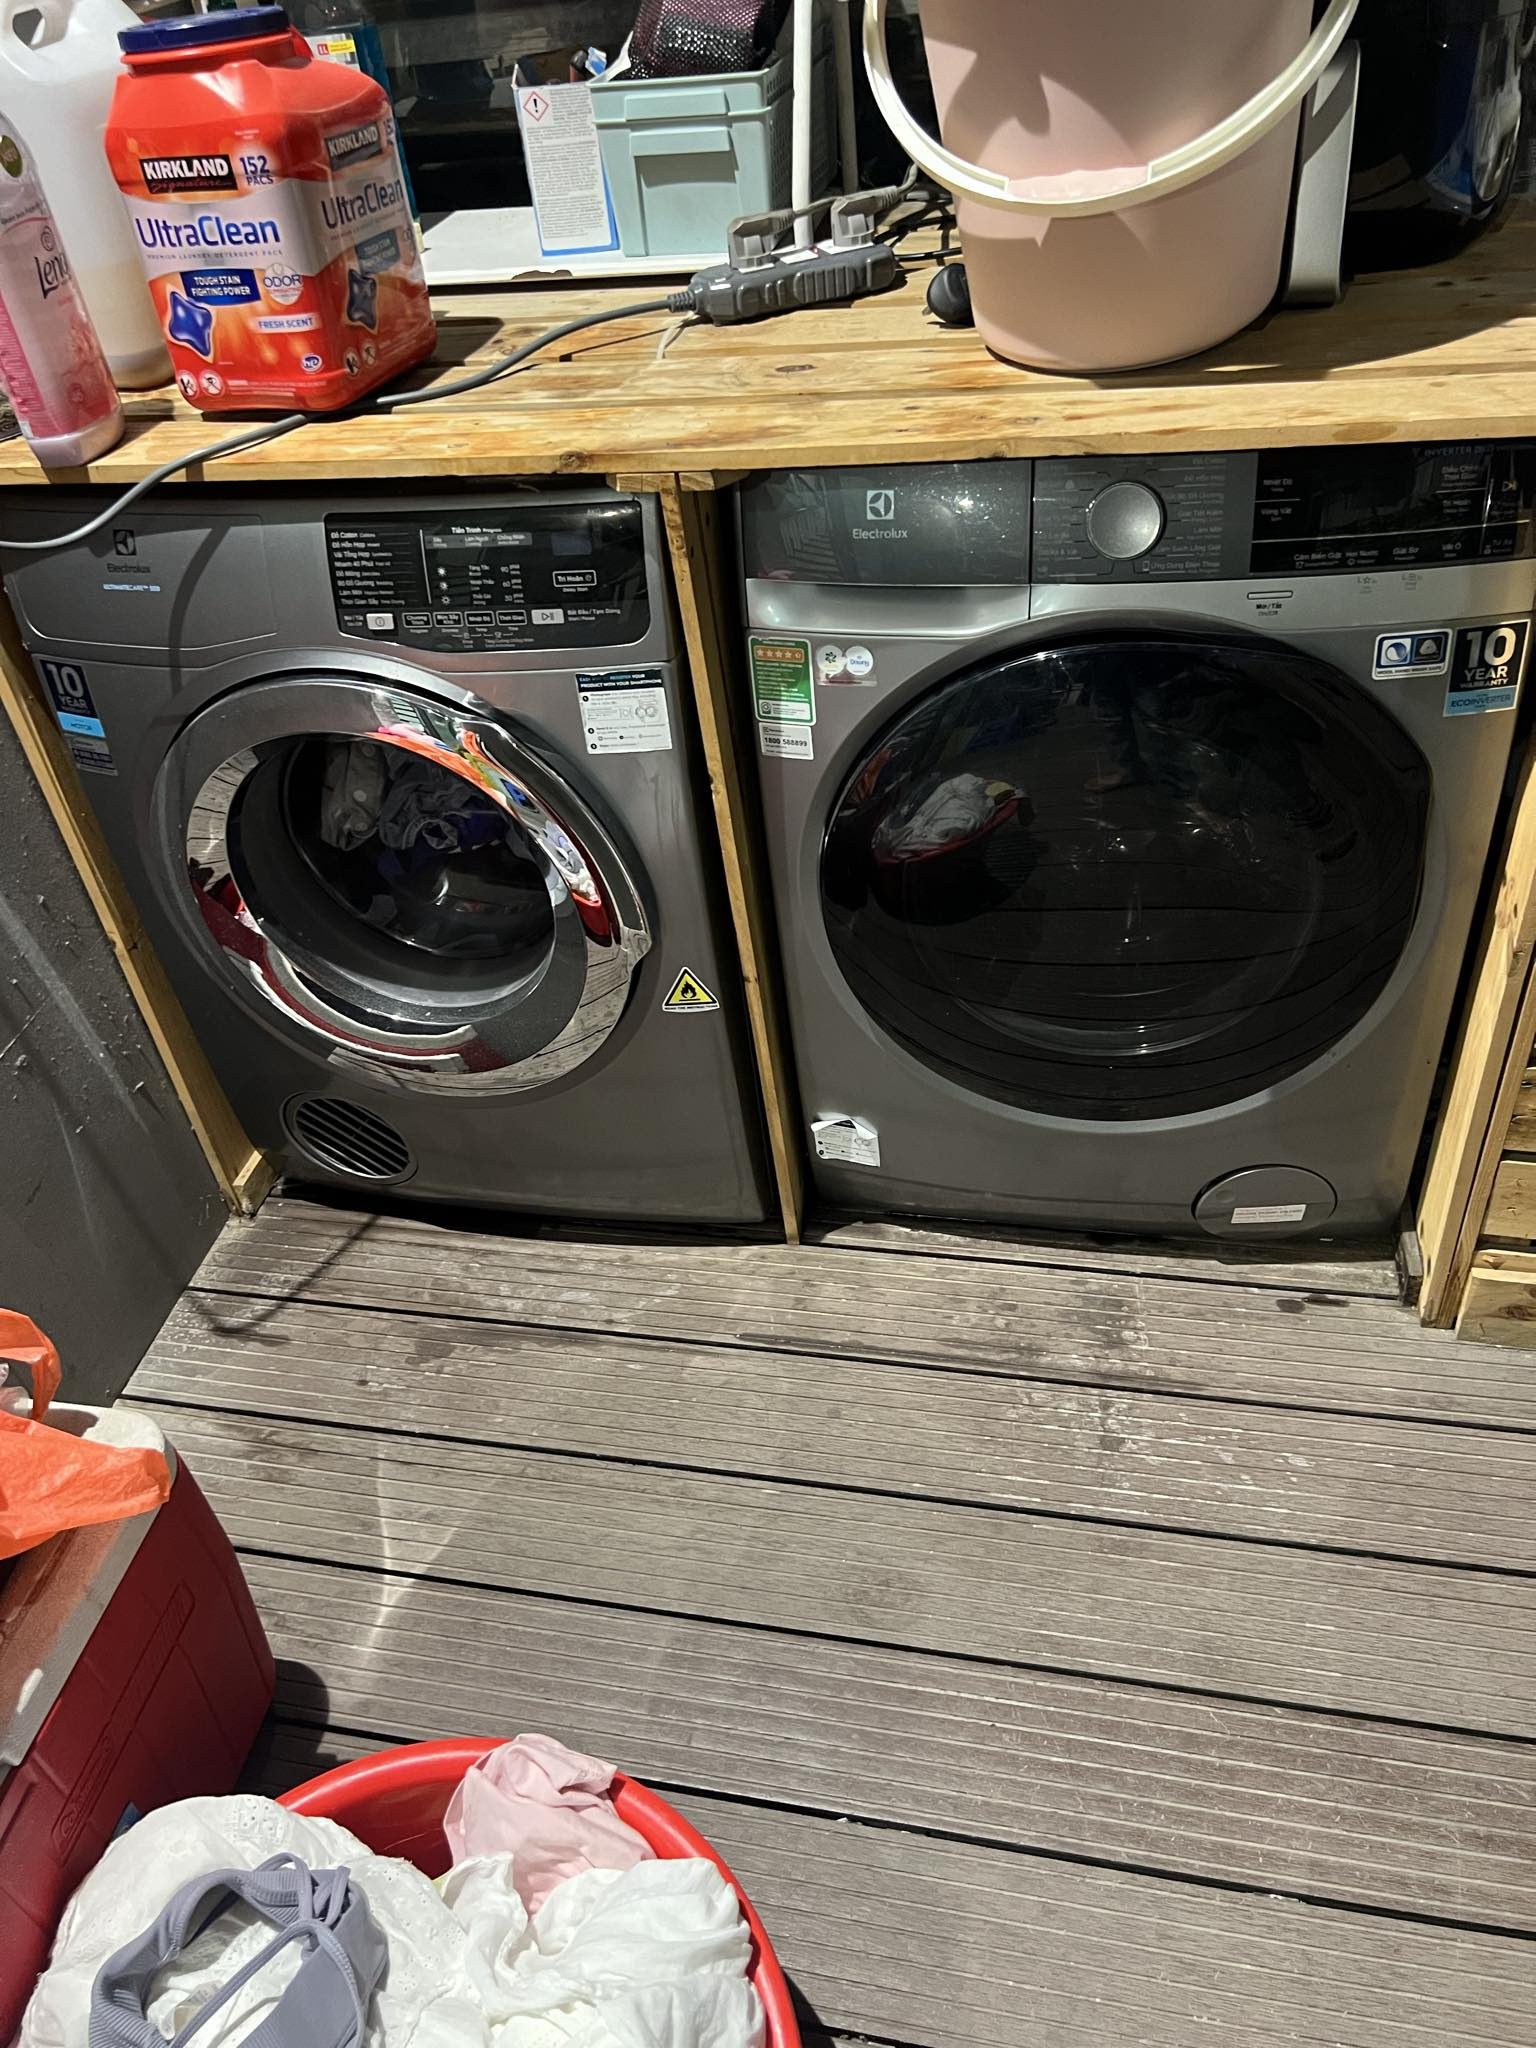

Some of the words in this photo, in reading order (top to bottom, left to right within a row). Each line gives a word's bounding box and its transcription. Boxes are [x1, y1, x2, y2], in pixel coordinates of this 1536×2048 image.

[327, 126, 379, 157] KIRKLAND
[143, 158, 229, 180] KIRKLAND
[240, 155, 270, 175] 152
[247, 175, 274, 186] PACS
[321, 180, 404, 230] UltraClean
[135, 215, 281, 248] UltraClean
[194, 276, 218, 285] TOUGH
[219, 275, 241, 285] STAIN
[263, 274, 303, 288] ODOR
[192, 288, 223, 297] FIGHTING
[223, 287, 251, 296] POWER
[258, 319, 285, 329] FRESH
[286, 318, 314, 328] SCENT
[852, 528, 908, 540] Electrolux
[1466, 627, 1516, 668] 10
[46, 663, 84, 698] 10
[1464, 665, 1508, 682] YEAR
[1460, 678, 1509, 689] WARRANTY
[58, 694, 87, 707] YEAR
[1451, 694, 1511, 707] ECOINVERTER
